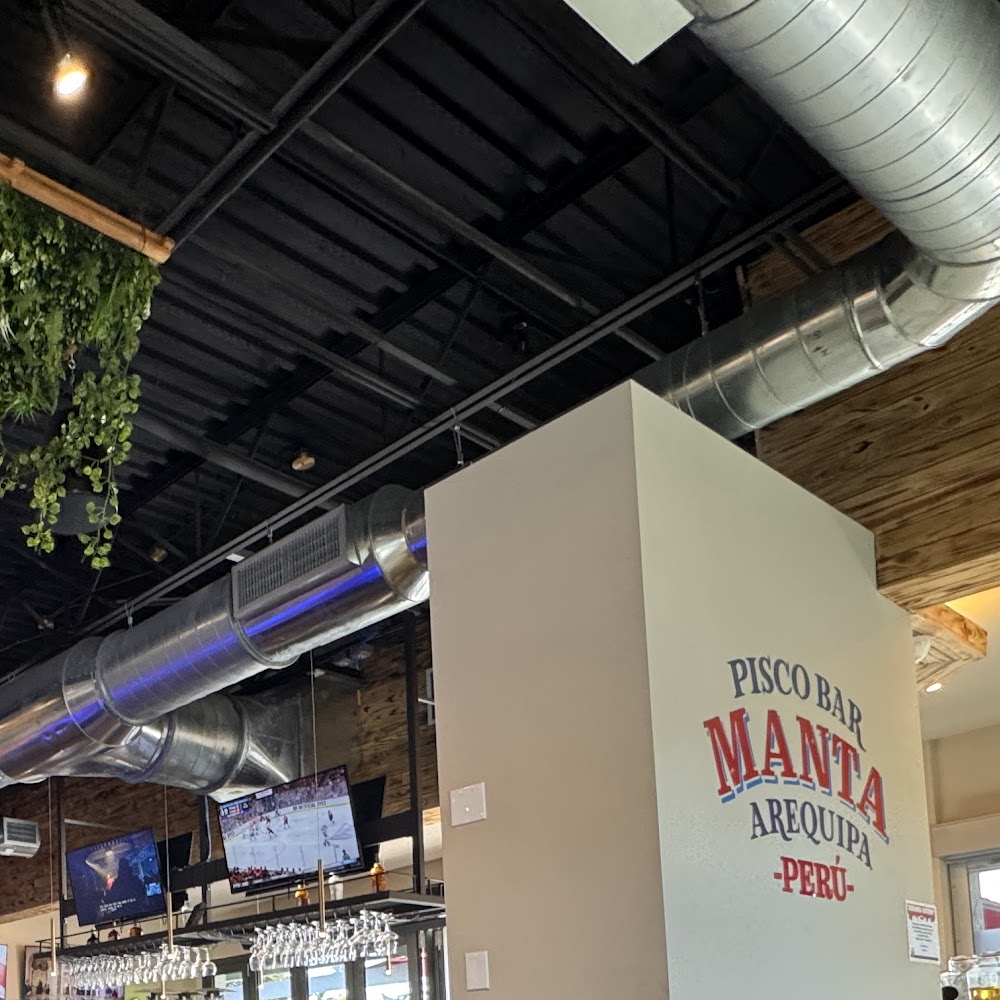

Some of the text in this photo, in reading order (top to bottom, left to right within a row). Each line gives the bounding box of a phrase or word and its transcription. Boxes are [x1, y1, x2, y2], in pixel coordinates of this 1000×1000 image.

[727, 656, 867, 752] PISCO BAR
[703, 707, 890, 845] MANTA
[749, 798, 873, 870] AREQUIPA
[773, 855, 855, 902] -PERÚ-
